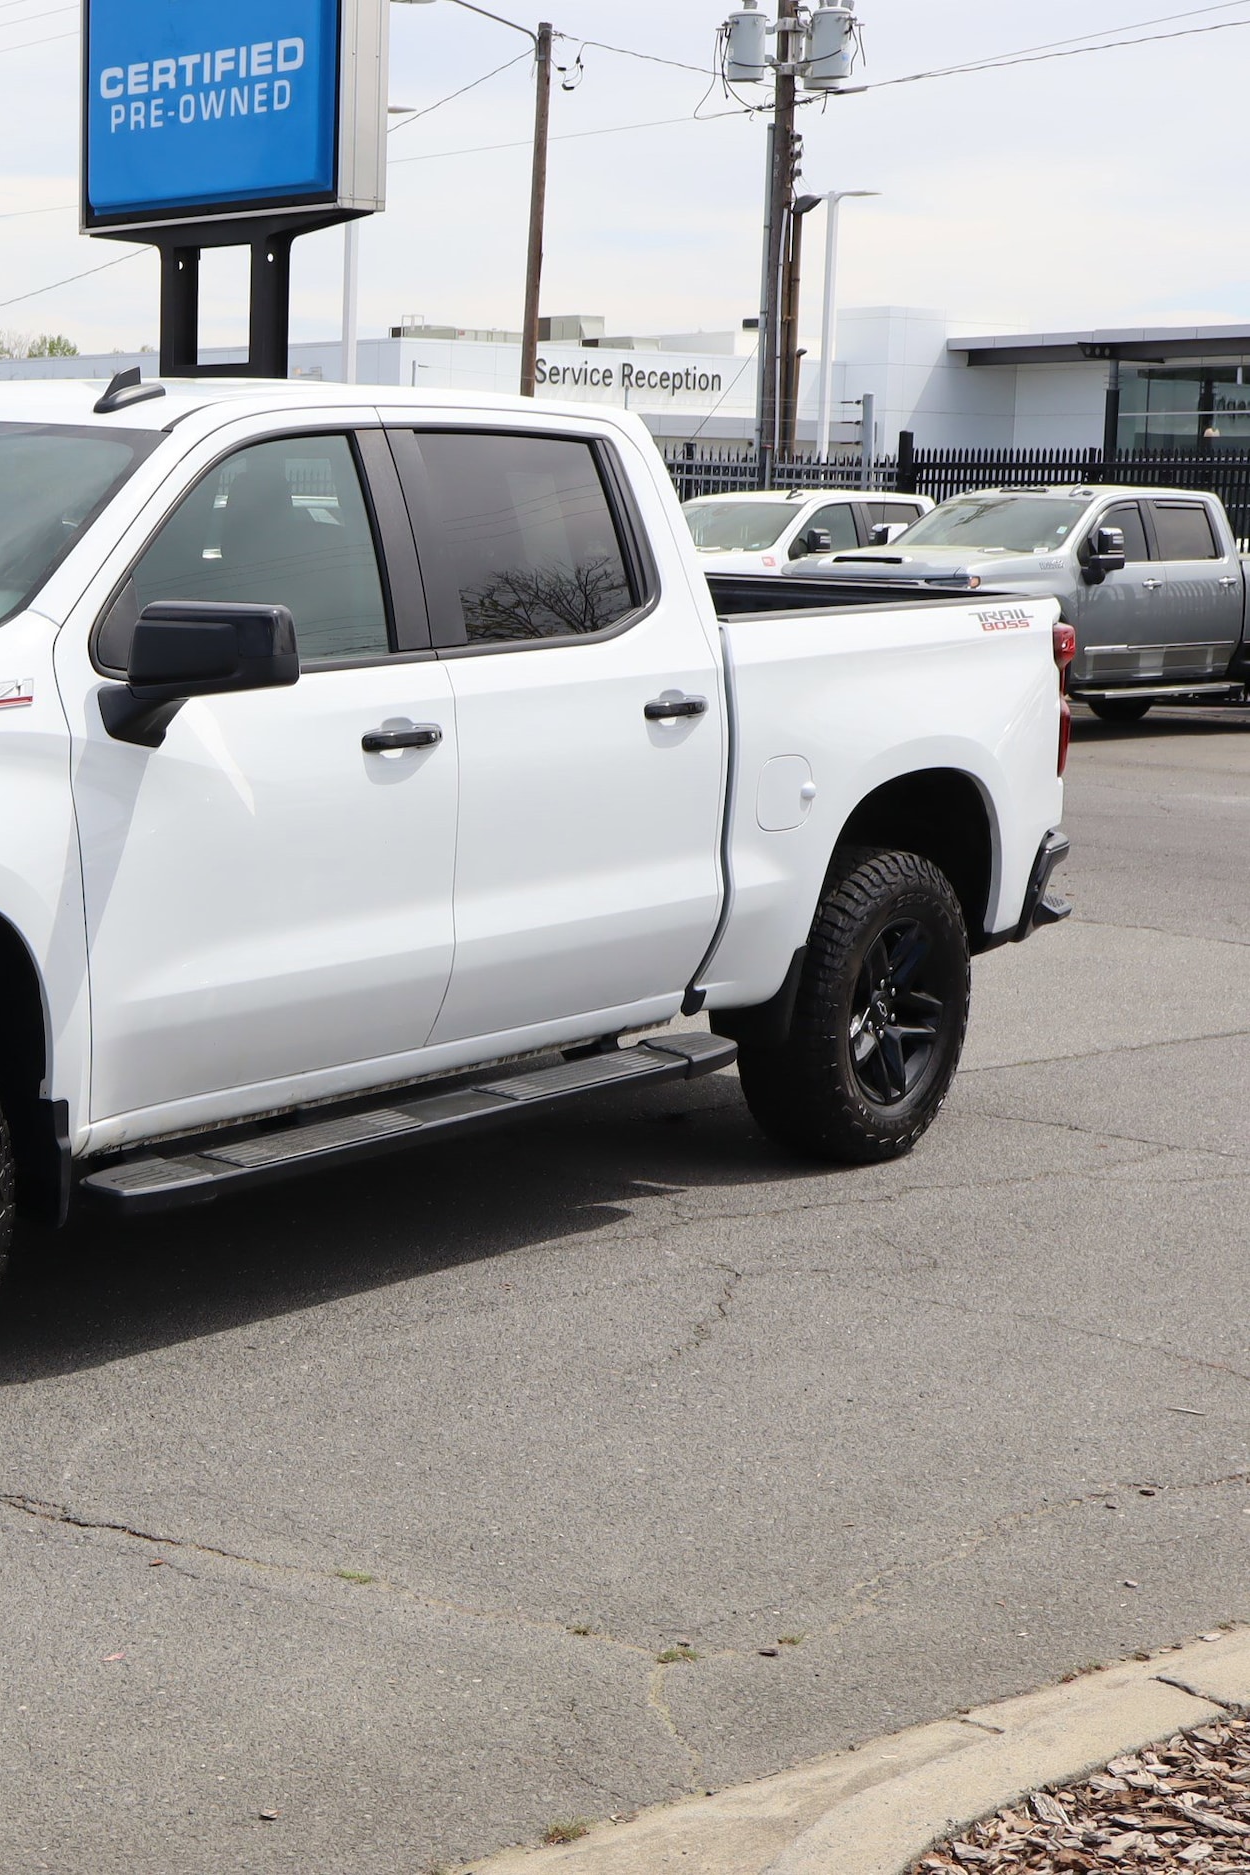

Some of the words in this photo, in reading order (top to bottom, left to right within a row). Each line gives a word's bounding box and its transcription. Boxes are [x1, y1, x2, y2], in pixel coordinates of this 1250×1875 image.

[100, 37, 305, 99] CERTIFIED
[111, 79, 291, 133] PRE-OWNED
[534, 358, 614, 388] Service
[621, 362, 722, 396] Reception
[968, 608, 1034, 622] TRAIL
[981, 619, 1031, 632] BOSS
